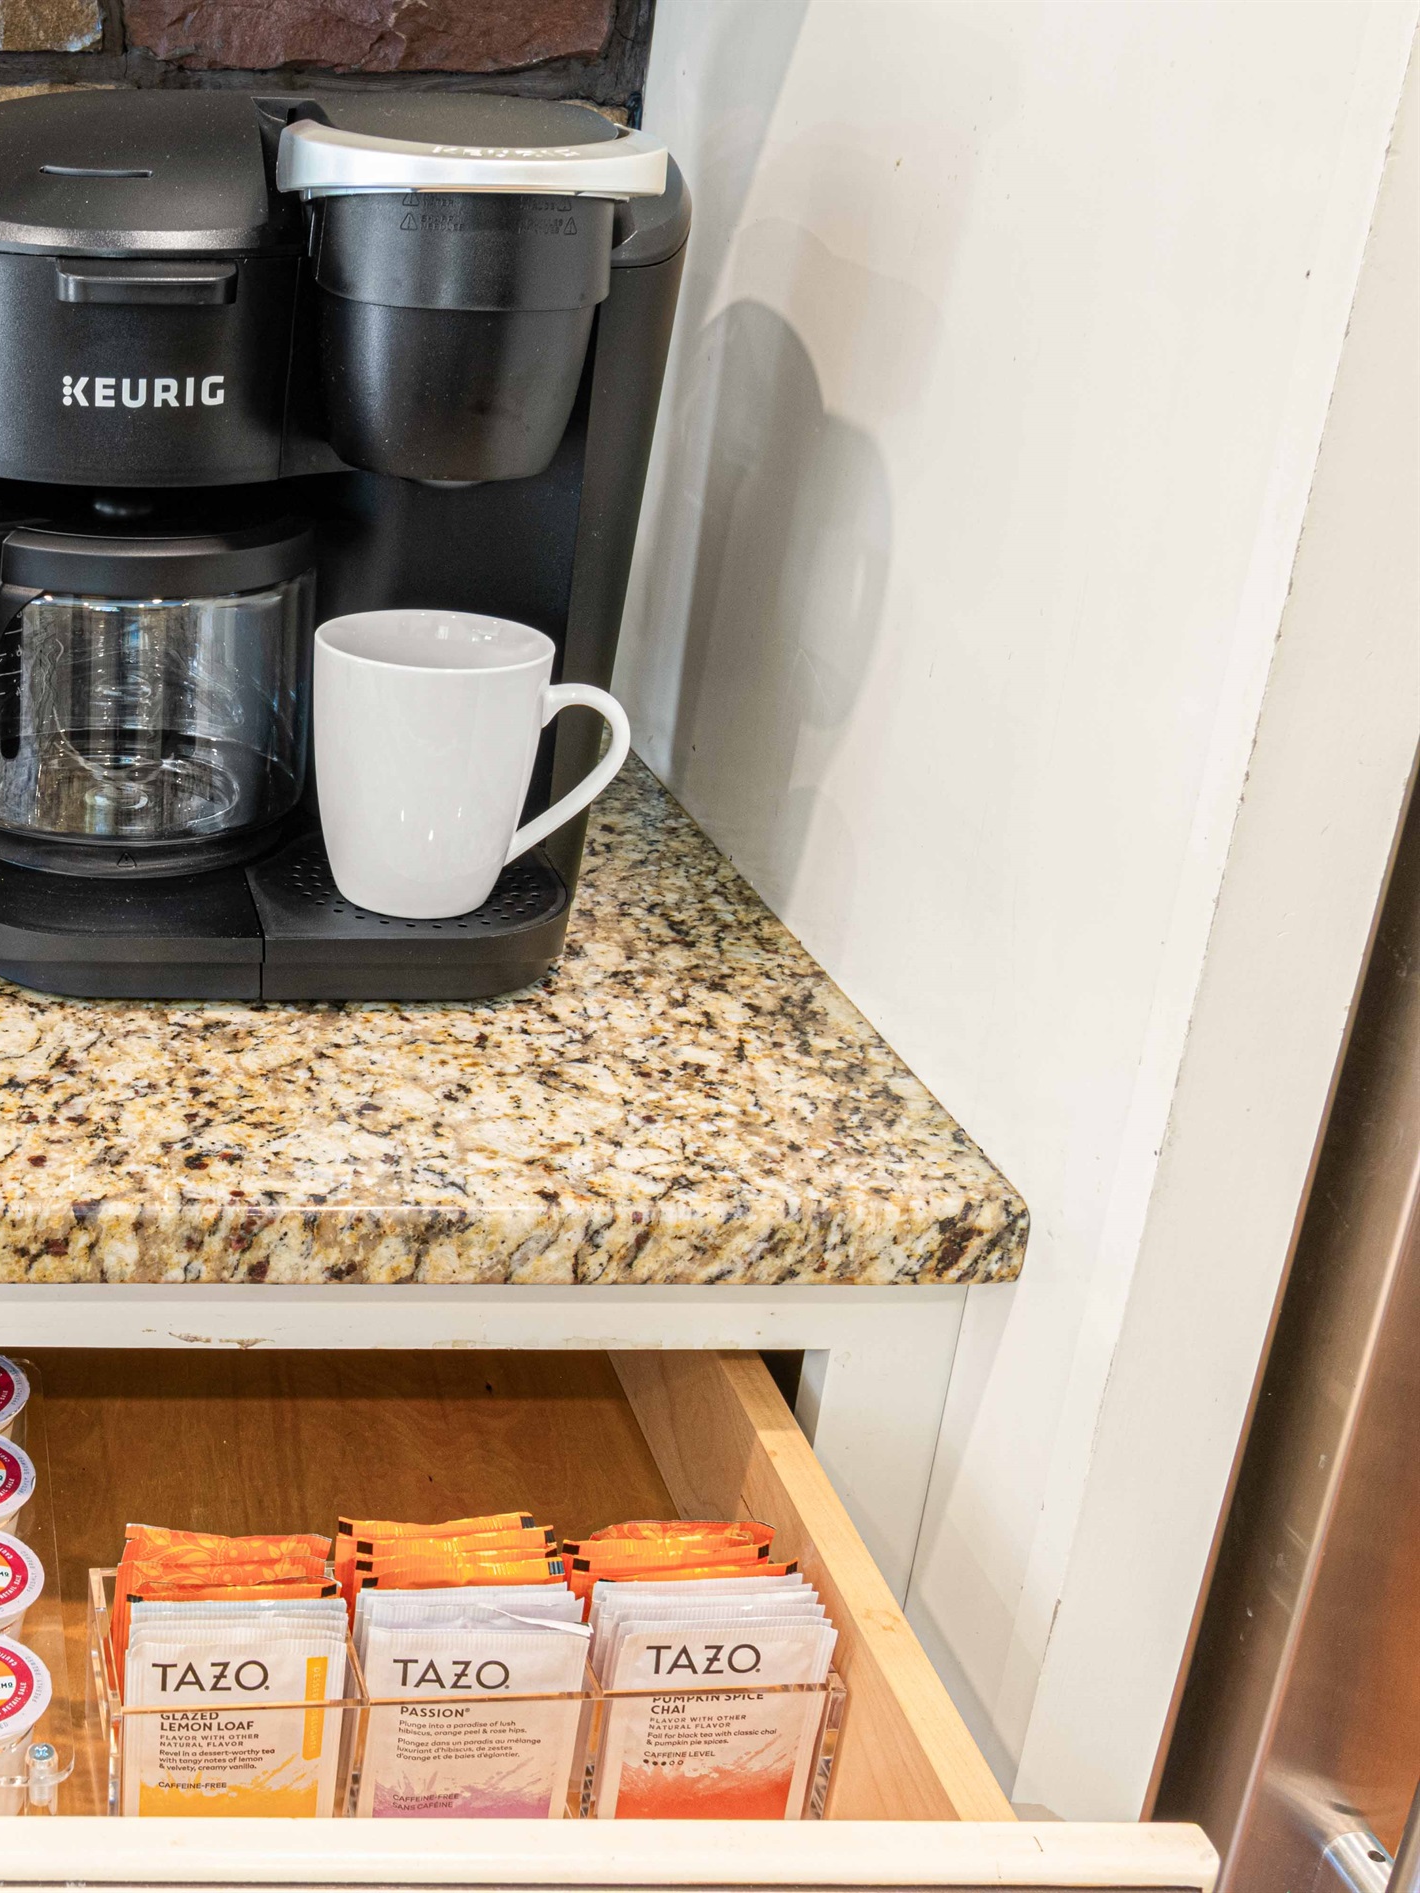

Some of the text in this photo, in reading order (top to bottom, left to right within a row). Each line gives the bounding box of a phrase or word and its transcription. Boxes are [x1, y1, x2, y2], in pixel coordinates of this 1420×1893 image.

[62, 375, 225, 408] KEURIG
[646, 1643, 761, 1675] TAZO
[151, 1659, 269, 1692] TAZO
[392, 1658, 510, 1690] TAZO
[652, 1693, 764, 1704] PUMPKIN SPICE
[651, 1705, 686, 1714] CHAI
[160, 1712, 219, 1720] GLAZED
[160, 1721, 254, 1732] LEMON LOAF
[399, 1720, 427, 1729] Plunge
[453, 1721, 488, 1730] paradise
[398, 1727, 433, 1737] hibiscus,
[434, 1729, 462, 1737] orange
[463, 1728, 480, 1736] peel
[508, 1727, 527, 1735] hips.
[397, 1738, 429, 1747] Plongez
[463, 1738, 493, 1747] paradis
[507, 1737, 541, 1746] mélange
[654, 1739, 689, 1747] pumpkin
[690, 1738, 702, 1746] pie
[702, 1738, 729, 1746] spices.
[198, 1749, 260, 1757] dessert-worthy
[396, 1745, 432, 1754] luxuriant
[396, 1752, 431, 1762] d'orange
[166, 1764, 196, 1772] velvety,
[158, 1781, 227, 1789] CAFFEINE-FREE
[392, 1793, 459, 1801] CAFFEINE-FREE
[392, 1801, 453, 1811] SANS CAFÉINE
